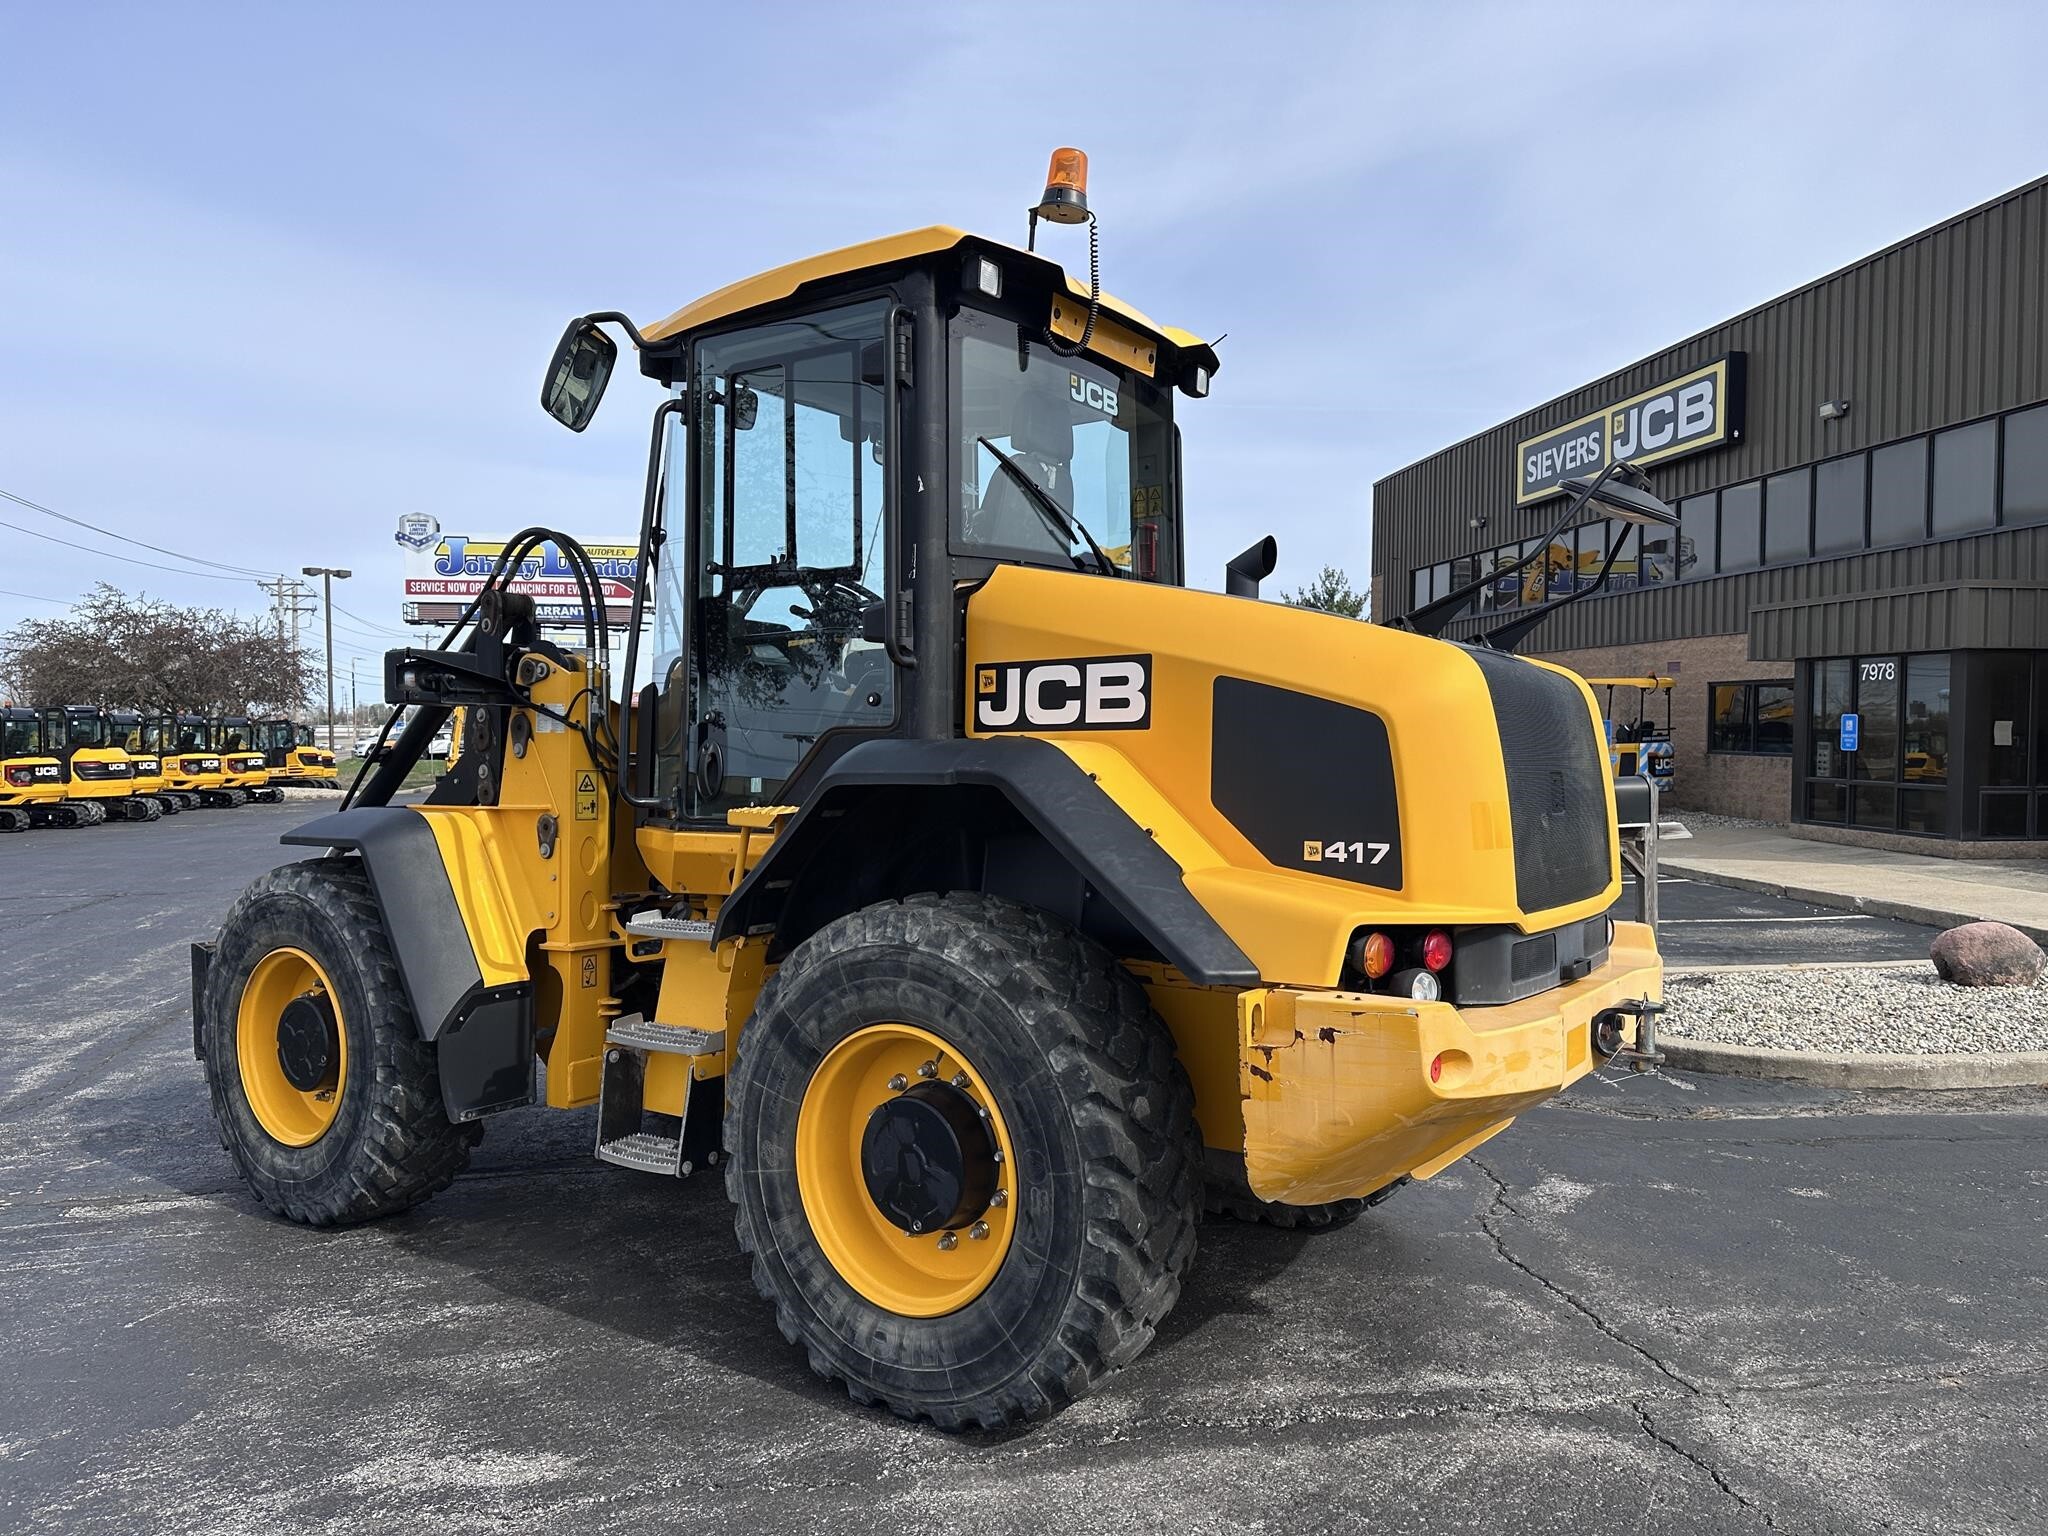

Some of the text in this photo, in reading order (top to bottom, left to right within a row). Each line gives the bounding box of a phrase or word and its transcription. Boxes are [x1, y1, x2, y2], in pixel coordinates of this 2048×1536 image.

[1071, 378, 1119, 416] JCB
[1527, 380, 1713, 483] SIEVERS JCB
[435, 536, 539, 580] Johy
[586, 548, 627, 557] AUTOPLEX
[410, 581, 446, 593] SERVICE
[447, 582, 468, 593] NOW
[469, 583, 489, 593] OPE
[505, 583, 547, 595] INANCING
[549, 584, 566, 595] FOR
[535, 606, 596, 616] ARRANT
[1861, 663, 1895, 681] 7978
[978, 661, 1146, 726] JCB
[138, 762, 157, 770] JCB
[201, 759, 219, 768] JCB
[247, 758, 263, 766] JCB
[35, 767, 58, 776] JCB
[1324, 841, 1390, 865] 417
